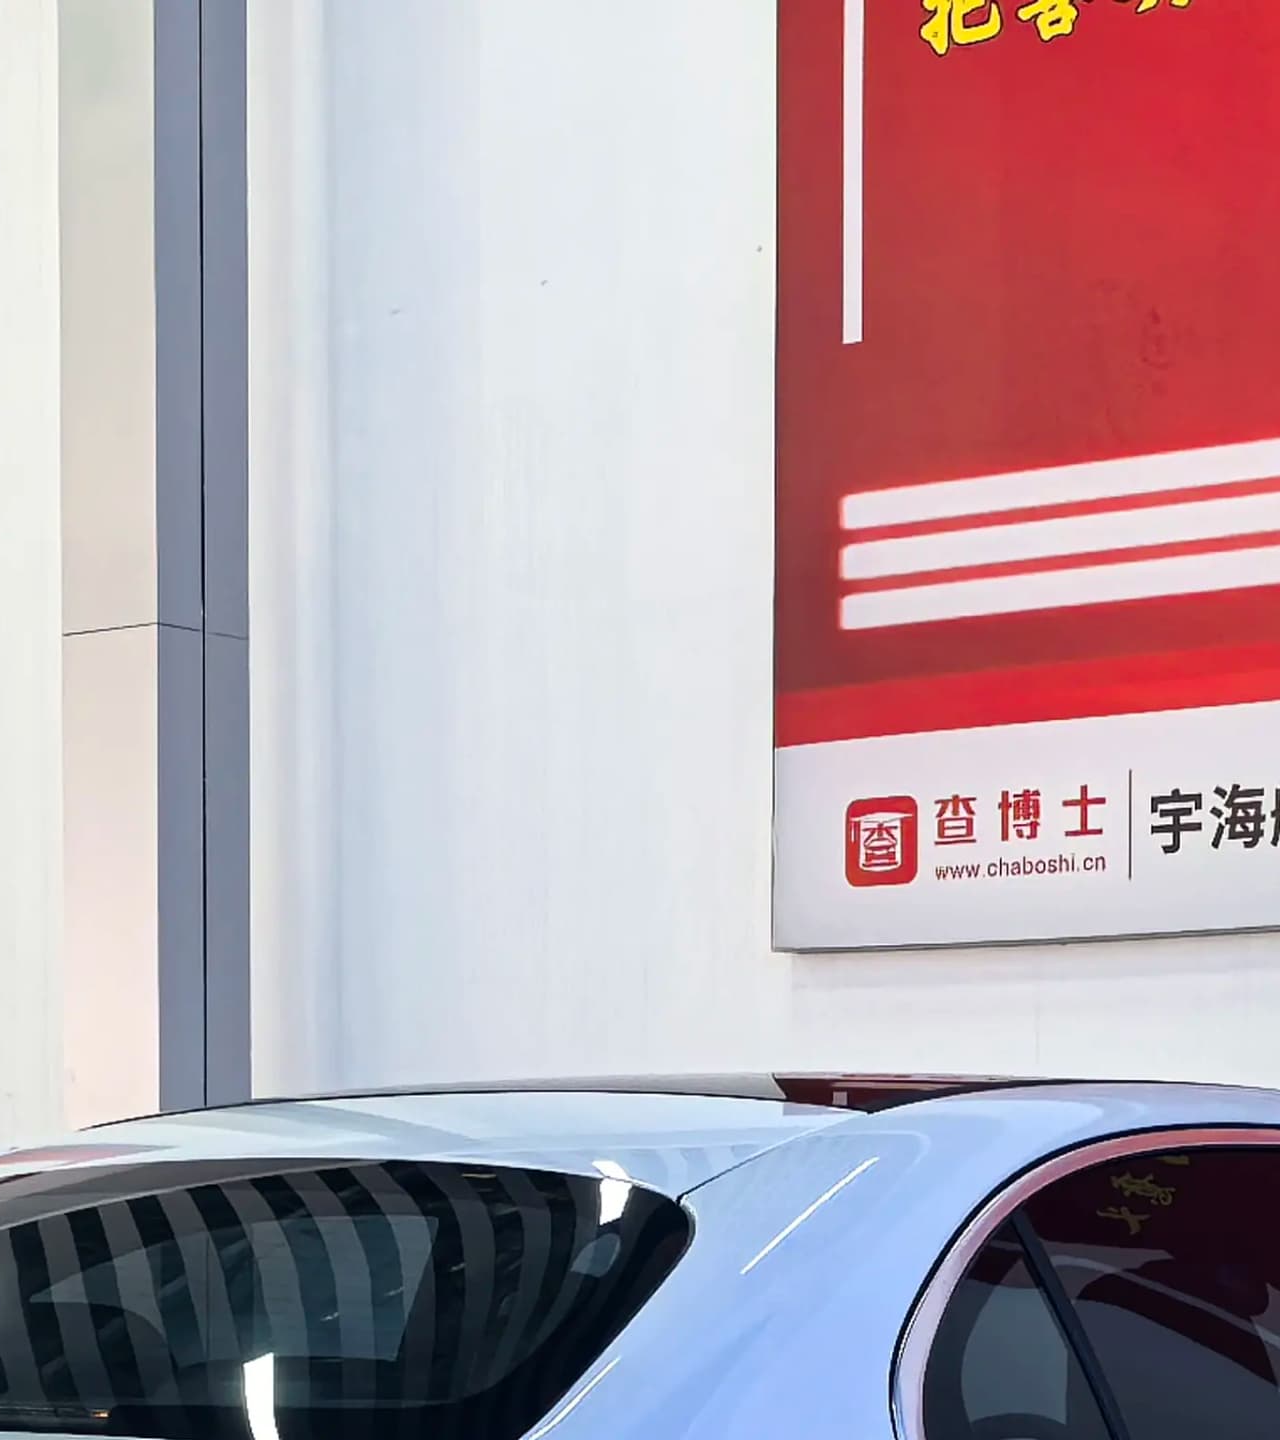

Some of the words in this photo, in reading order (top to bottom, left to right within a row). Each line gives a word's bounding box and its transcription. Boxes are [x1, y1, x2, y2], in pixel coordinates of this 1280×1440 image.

[934, 784, 1107, 845] 查博士
[934, 853, 1107, 881] www.chaboshi.cn
